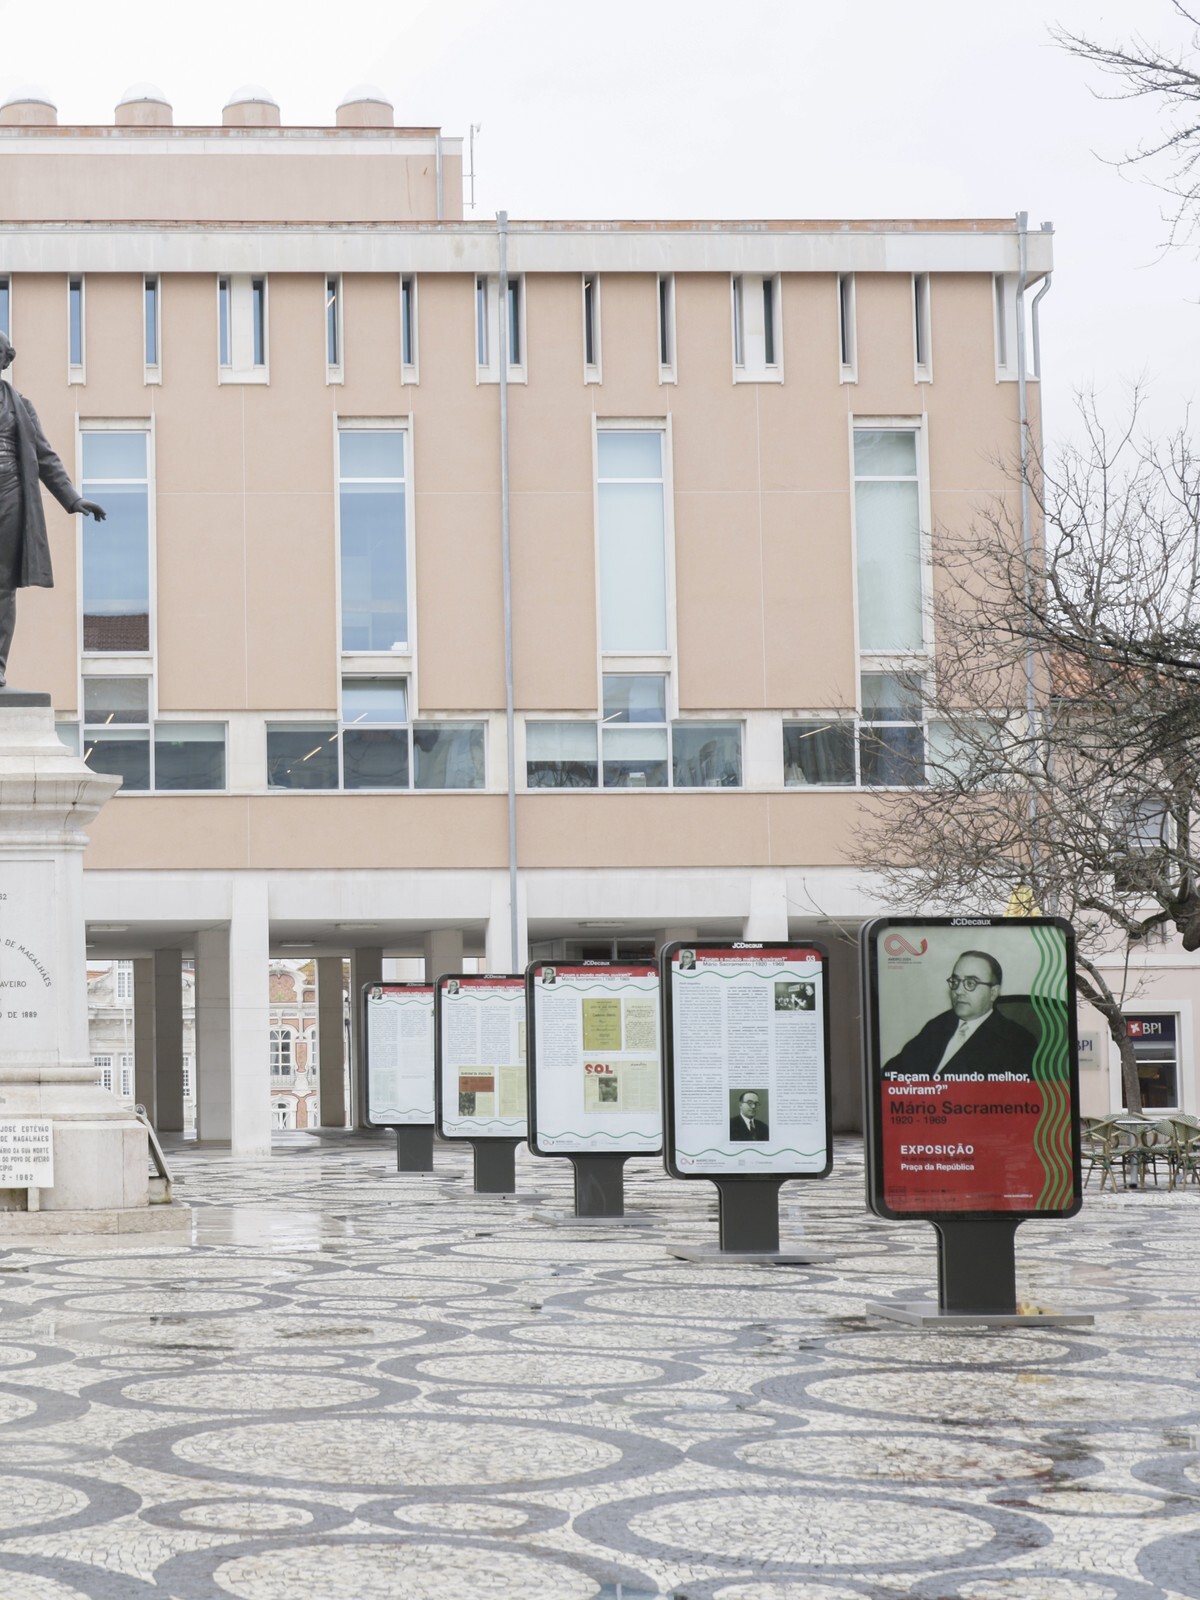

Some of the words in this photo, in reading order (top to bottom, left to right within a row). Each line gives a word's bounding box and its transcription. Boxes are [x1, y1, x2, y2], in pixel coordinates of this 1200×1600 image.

[951, 918, 991, 926] JCDecaux
[5, 939, 16, 948] DE
[1143, 1023, 1161, 1034] BPI
[585, 1064, 613, 1074] SOL
[933, 1073, 940, 1082] o
[944, 1072, 985, 1082] mundo
[988, 1072, 1030, 1083] melhor,
[888, 1084, 948, 1095] ouviram?”
[890, 1101, 937, 1114] Mário
[942, 1101, 1040, 1114] Sacramento
[891, 1116, 913, 1124] 1920
[925, 1116, 947, 1124] 1969
[0, 1124, 16, 1132] JOSÉ
[901, 1143, 974, 1156] EXPOSIÇÃO
[901, 1164, 922, 1172] Praça
